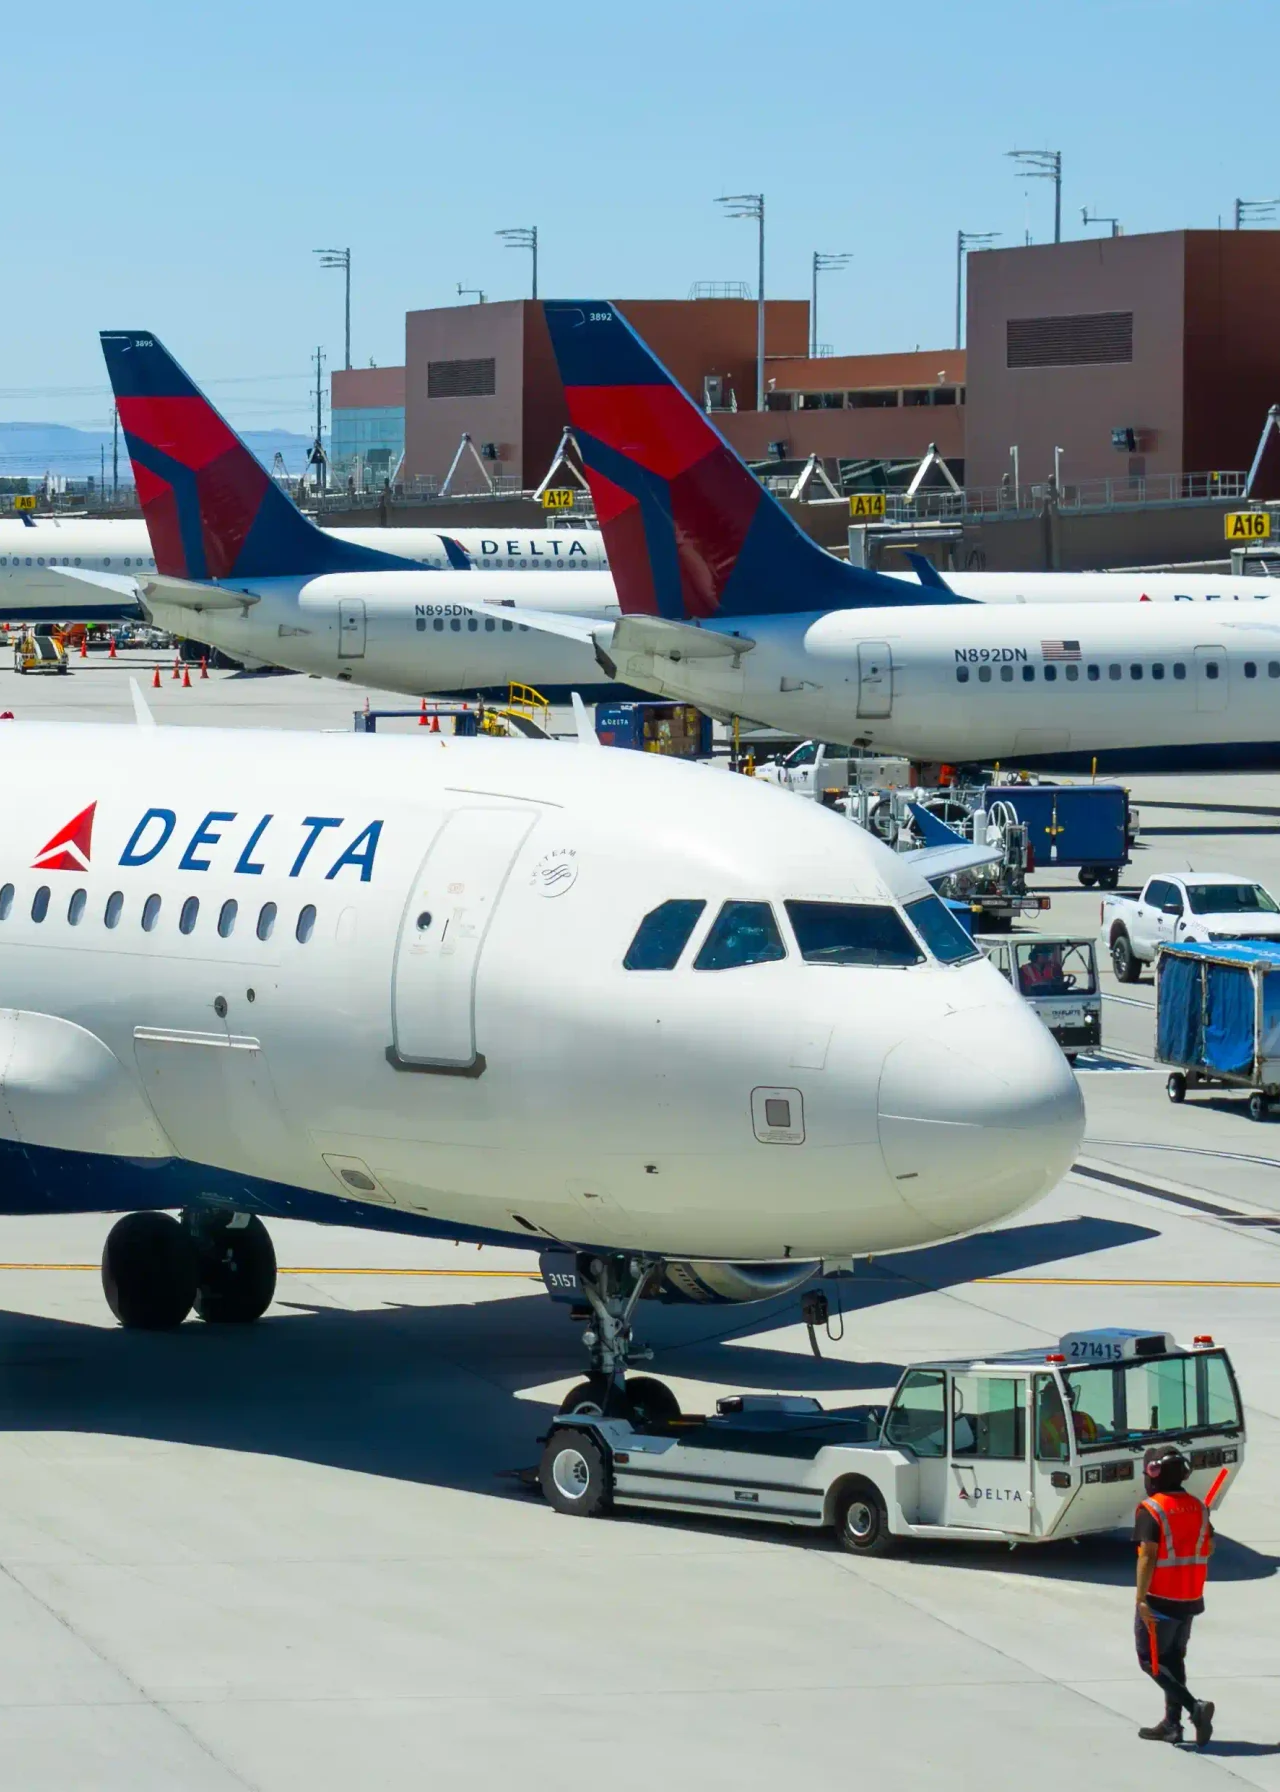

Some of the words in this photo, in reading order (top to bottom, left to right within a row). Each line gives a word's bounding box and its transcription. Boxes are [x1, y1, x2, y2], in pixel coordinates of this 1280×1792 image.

[590, 313, 612, 321] 3892
[20, 497, 31, 507] A6
[548, 491, 570, 505] A12
[855, 496, 882, 514] A14
[1233, 514, 1264, 535] A16
[481, 540, 587, 555] DELTA
[415, 605, 473, 616] N895DN
[955, 648, 1027, 662] N892DN
[118, 807, 384, 882] DELTA
[549, 1273, 576, 1288] 3157
[1071, 1341, 1122, 1359] 271415
[974, 1488, 1022, 1501] DELTA
